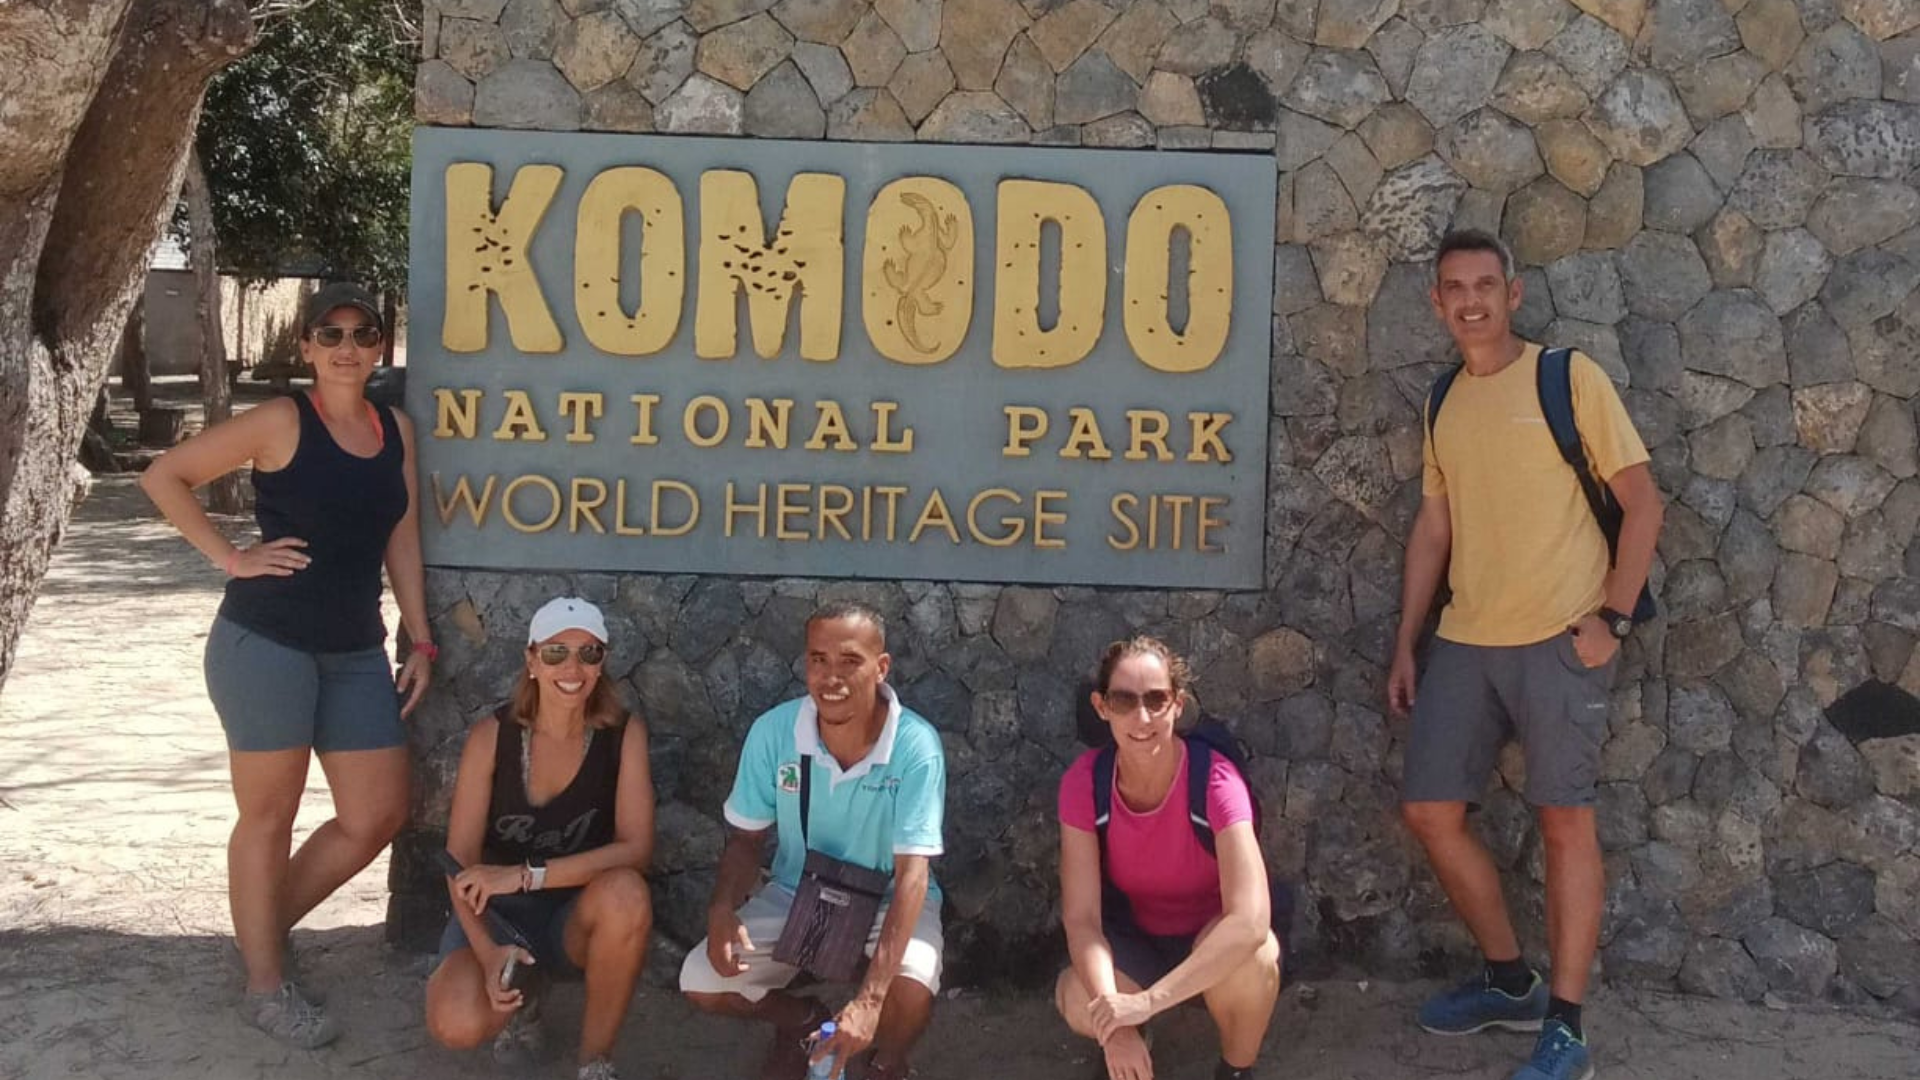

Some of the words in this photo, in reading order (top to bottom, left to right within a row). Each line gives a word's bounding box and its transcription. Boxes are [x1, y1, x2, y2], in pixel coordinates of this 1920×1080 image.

[441, 162, 1233, 373] KOMODO
[434, 388, 915, 454] NATIONAL
[1003, 405, 1234, 464] PARK
[431, 472, 701, 537] WORLD
[724, 481, 1069, 548] HERITAGE
[1106, 492, 1229, 554] SITE
